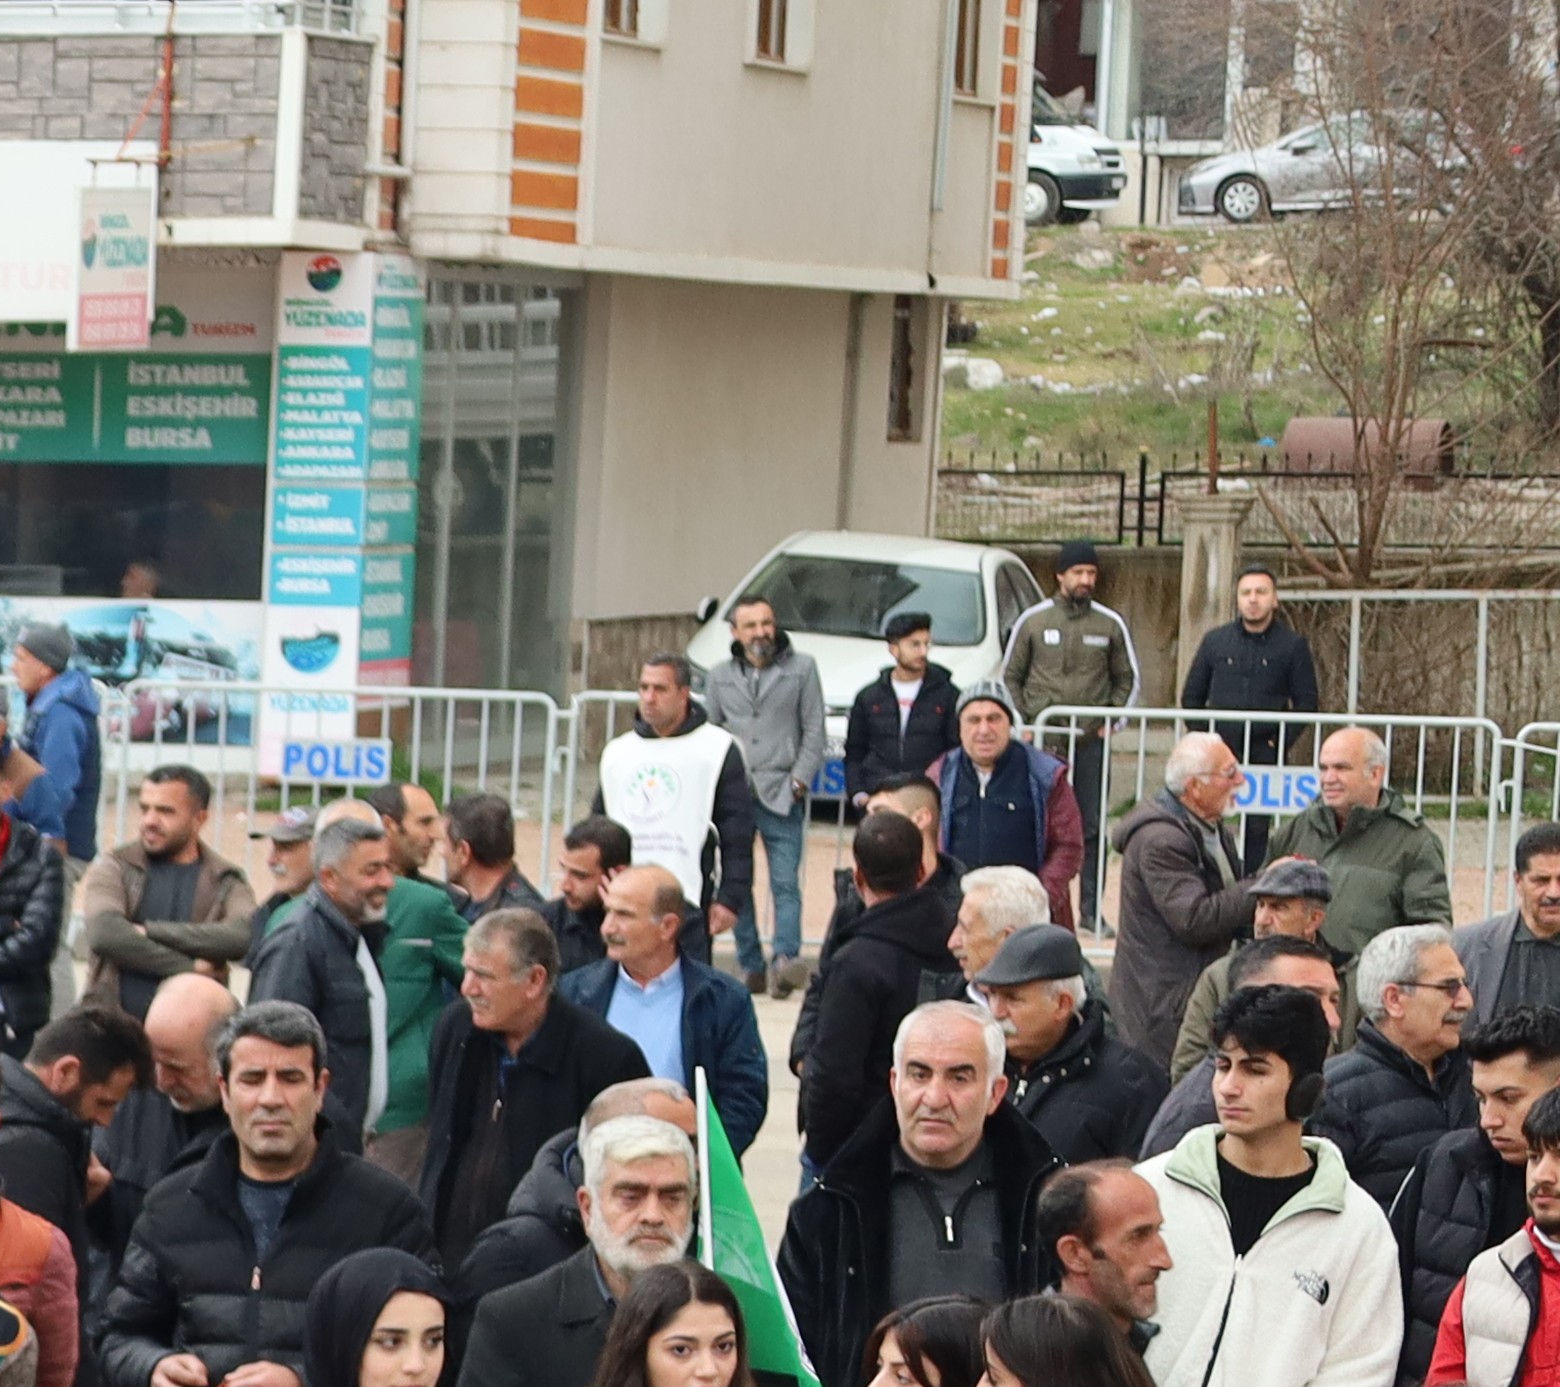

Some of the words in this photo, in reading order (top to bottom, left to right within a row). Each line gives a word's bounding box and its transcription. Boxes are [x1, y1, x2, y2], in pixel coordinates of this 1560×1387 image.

[127, 360, 252, 386] İSTANBUL
[127, 394, 258, 419] ESKİŞEHİR
[126, 427, 212, 450] BURSA
[1234, 771, 1318, 808] OLİS
